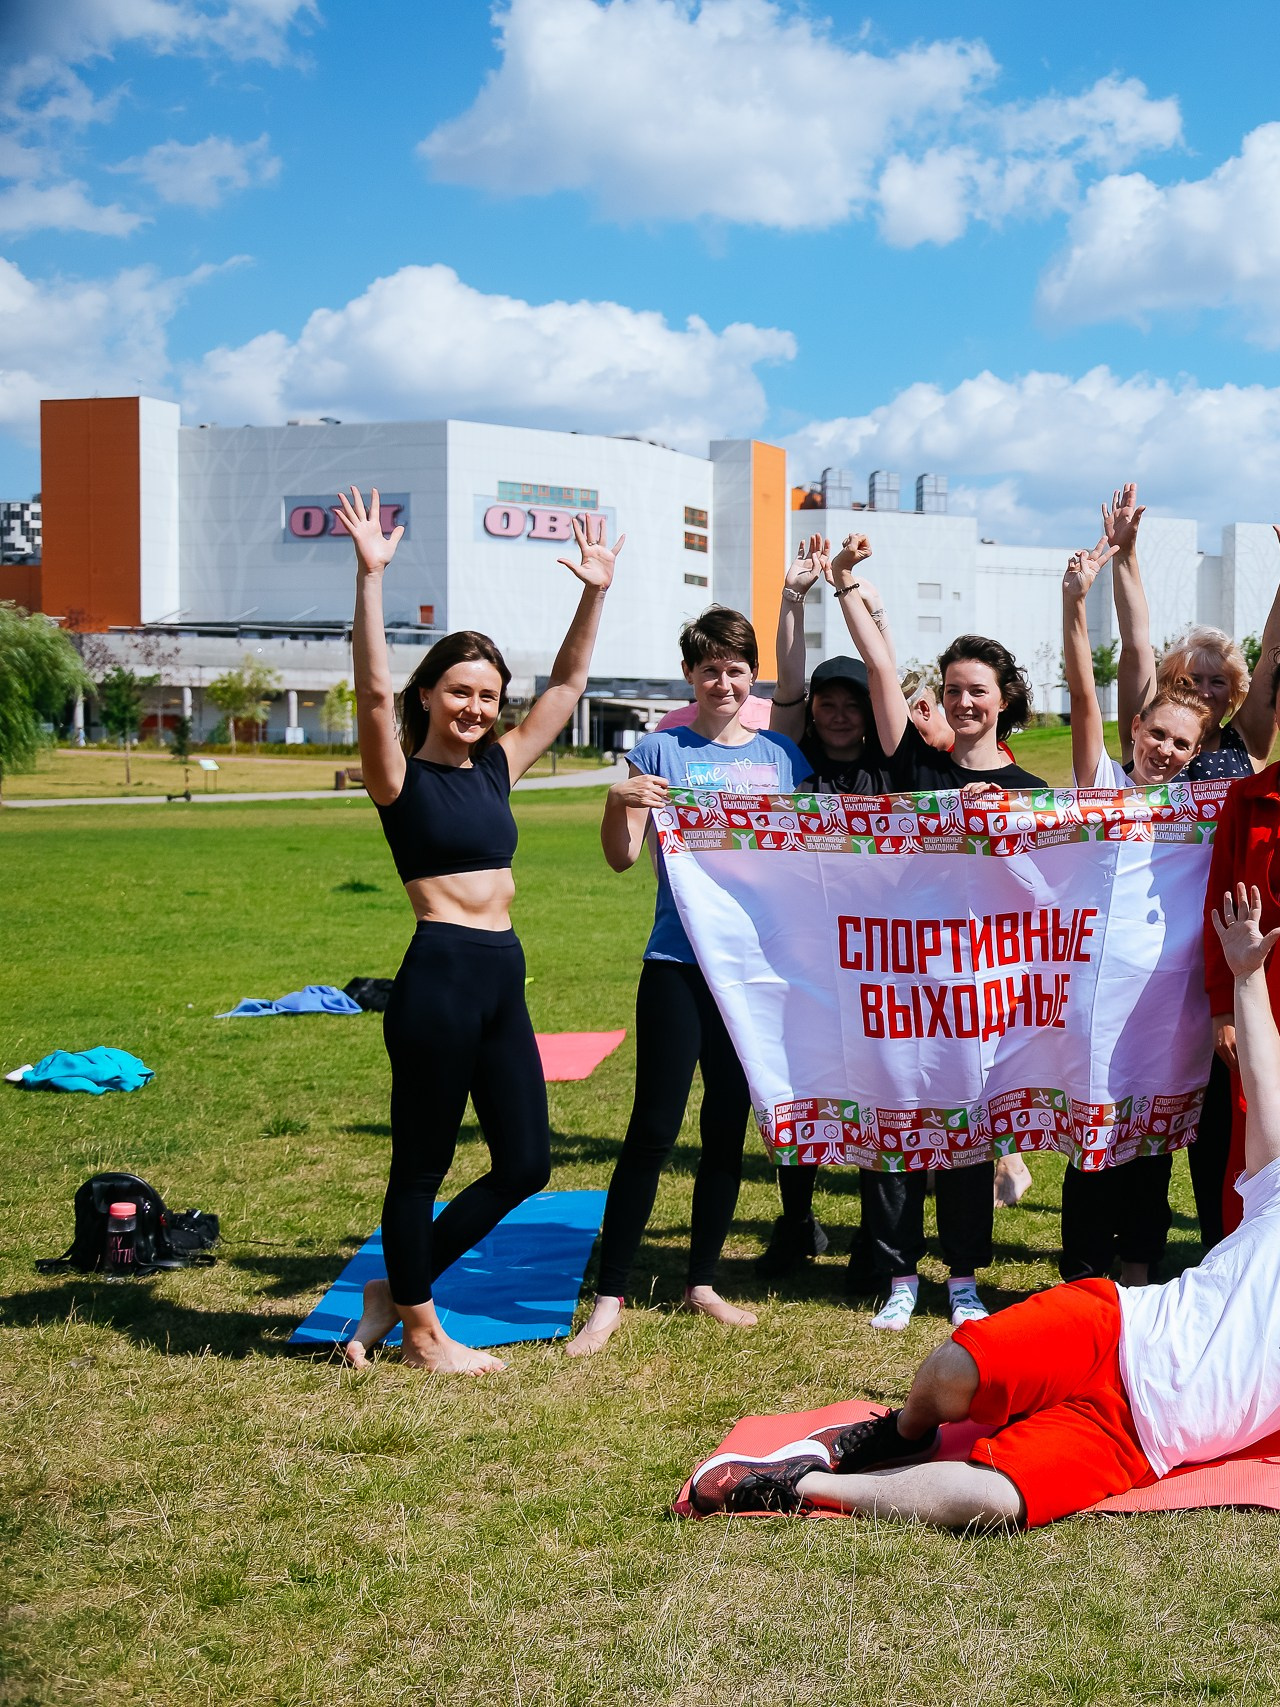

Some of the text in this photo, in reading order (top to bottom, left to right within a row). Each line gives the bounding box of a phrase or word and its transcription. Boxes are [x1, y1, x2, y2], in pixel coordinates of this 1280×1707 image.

[681, 757, 753, 787] time to
[718, 777, 753, 794] lax
[722, 800, 761, 810] ВЫХОДНЫЕ
[844, 802, 882, 812] ВЫХОДНЫЕ
[1153, 823, 1193, 832] СПОРТИВНЫЕ
[683, 830, 728, 840] СПОРТИВНЫЕ
[805, 836, 848, 844] СПОРТИВНЫЕ
[923, 836, 964, 844] СПОРТИВНЫЕ
[685, 839, 722, 848] ВЫХОДНЫЕ
[807, 843, 842, 851] ВЫХОДНЫЕ
[924, 843, 959, 851] ВЫХОДНЫЕ
[837, 908, 1099, 975] СПОРТИВНЫЕ
[860, 973, 1071, 1042] ВЫХОДНЫЕ
[989, 1090, 1027, 1108] СПОРТИВНЫЕ
[776, 1101, 814, 1115] СПОРТИВНЫЕ
[878, 1110, 918, 1120] СПОРТИВНЫЕ
[879, 1119, 913, 1128] ВЫХОДНЫЕ
